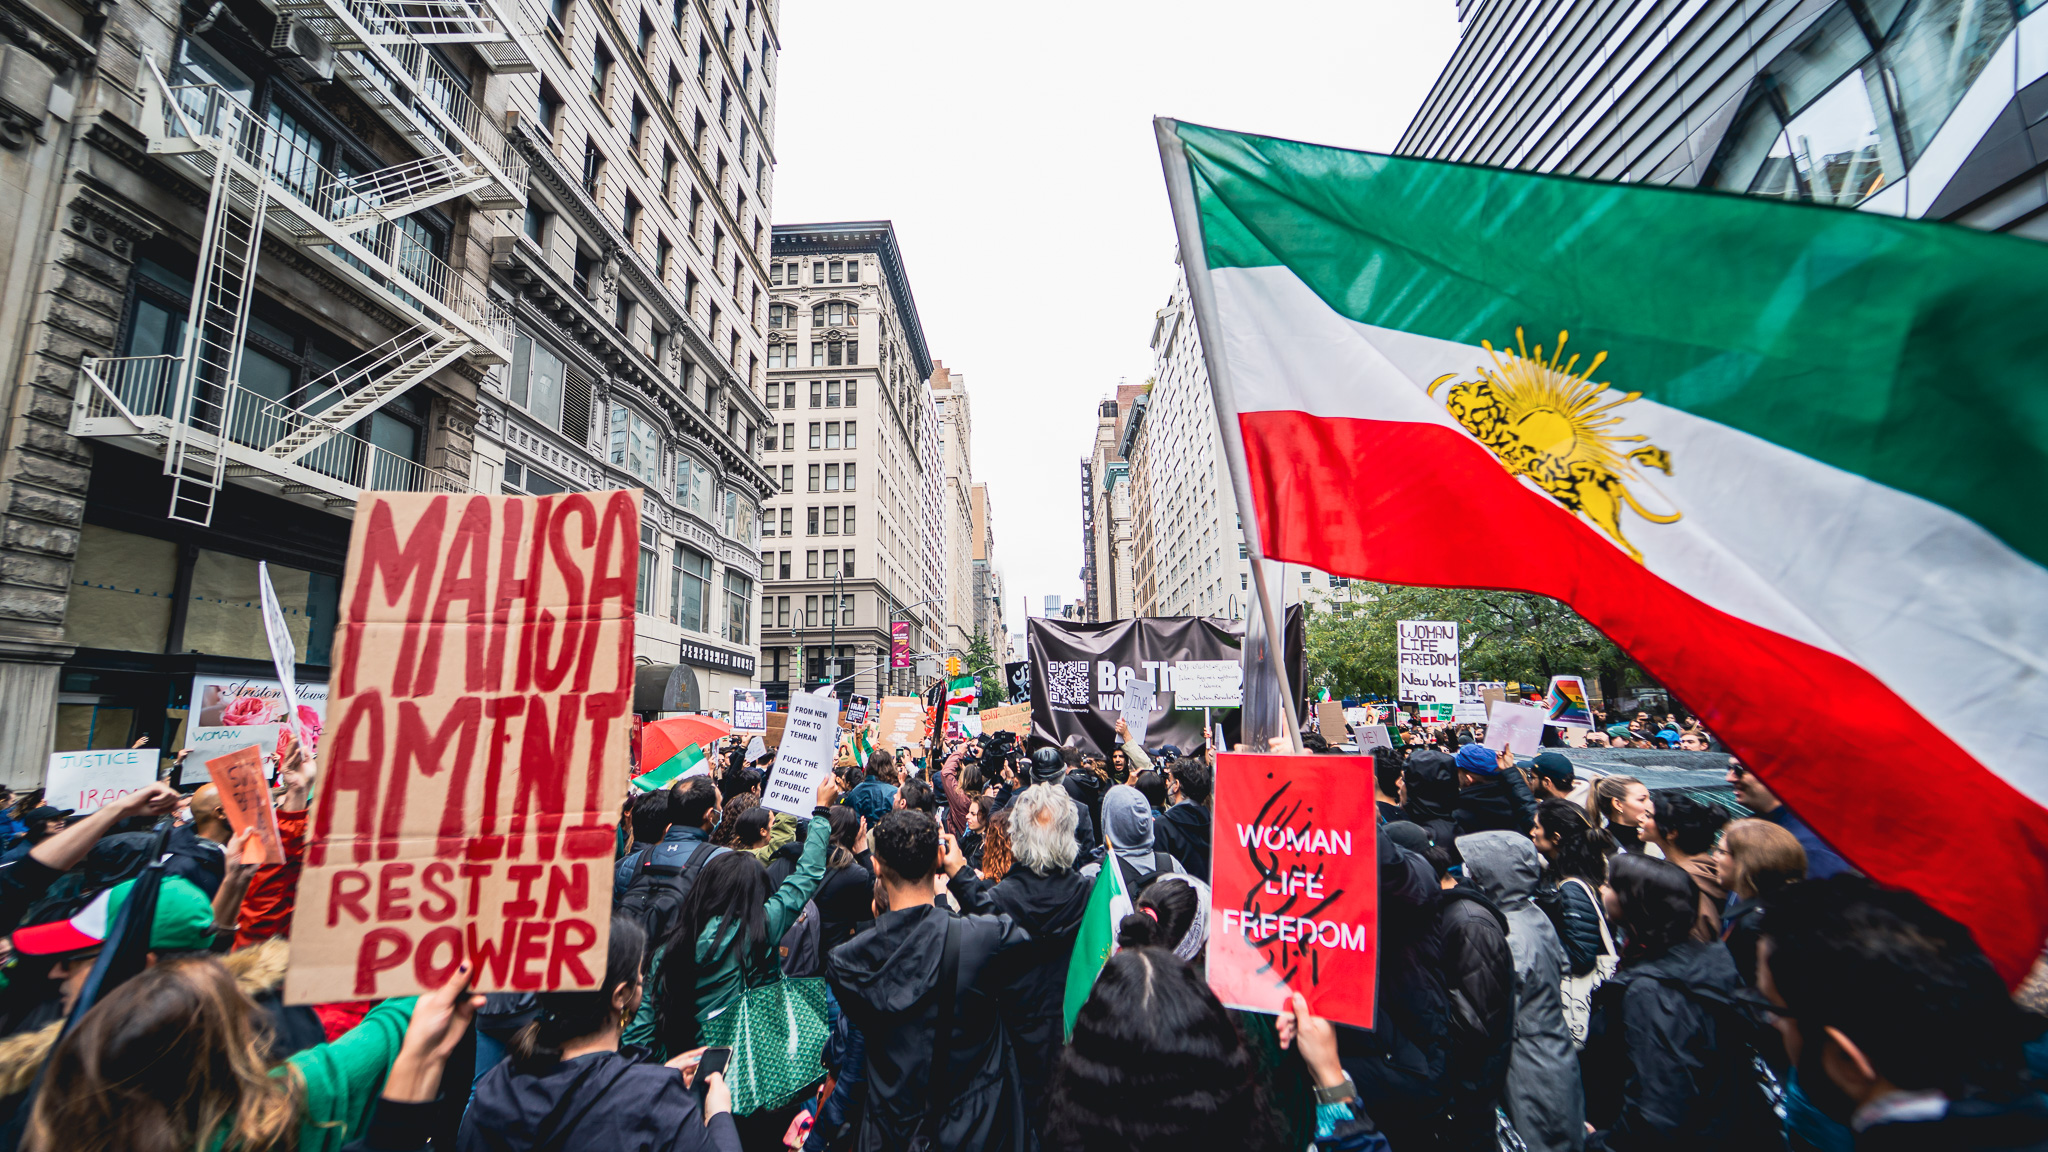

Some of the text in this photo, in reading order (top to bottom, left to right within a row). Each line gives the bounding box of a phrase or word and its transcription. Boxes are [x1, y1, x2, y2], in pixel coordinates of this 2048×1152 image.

[338, 490, 639, 700] MAHSA
[1400, 624, 1454, 639] WOMAN
[1400, 638, 1438, 652] LIFE
[682, 643, 753, 671] PERFORMIX HOUSE
[1400, 653, 1457, 666] FREEDOM
[1097, 661, 1176, 692] Be Th
[1401, 672, 1456, 688] New York
[222, 678, 281, 699] Ariston
[1401, 690, 1436, 702] Iran
[736, 700, 763, 712] IRAN
[794, 706, 828, 719] FROM NEW
[851, 702, 866, 712] IRAN
[793, 718, 822, 730] YORK TO
[192, 730, 241, 742] WOMAN
[790, 730, 817, 742] TEHRAN
[1362, 731, 1380, 744] HEY
[60, 752, 139, 769] JUSTICE
[782, 754, 819, 769] FUCK THE
[307, 687, 630, 867] AMINI
[778, 767, 808, 780] ISLAMIC
[774, 779, 810, 794] REPUBLIC
[770, 791, 800, 804] OF IRAN
[1236, 822, 1353, 856] WOMAN
[1265, 868, 1325, 900] LIFE
[326, 862, 590, 927] REST IN
[1222, 908, 1367, 952] FREEDOM
[353, 919, 598, 996] POWER
